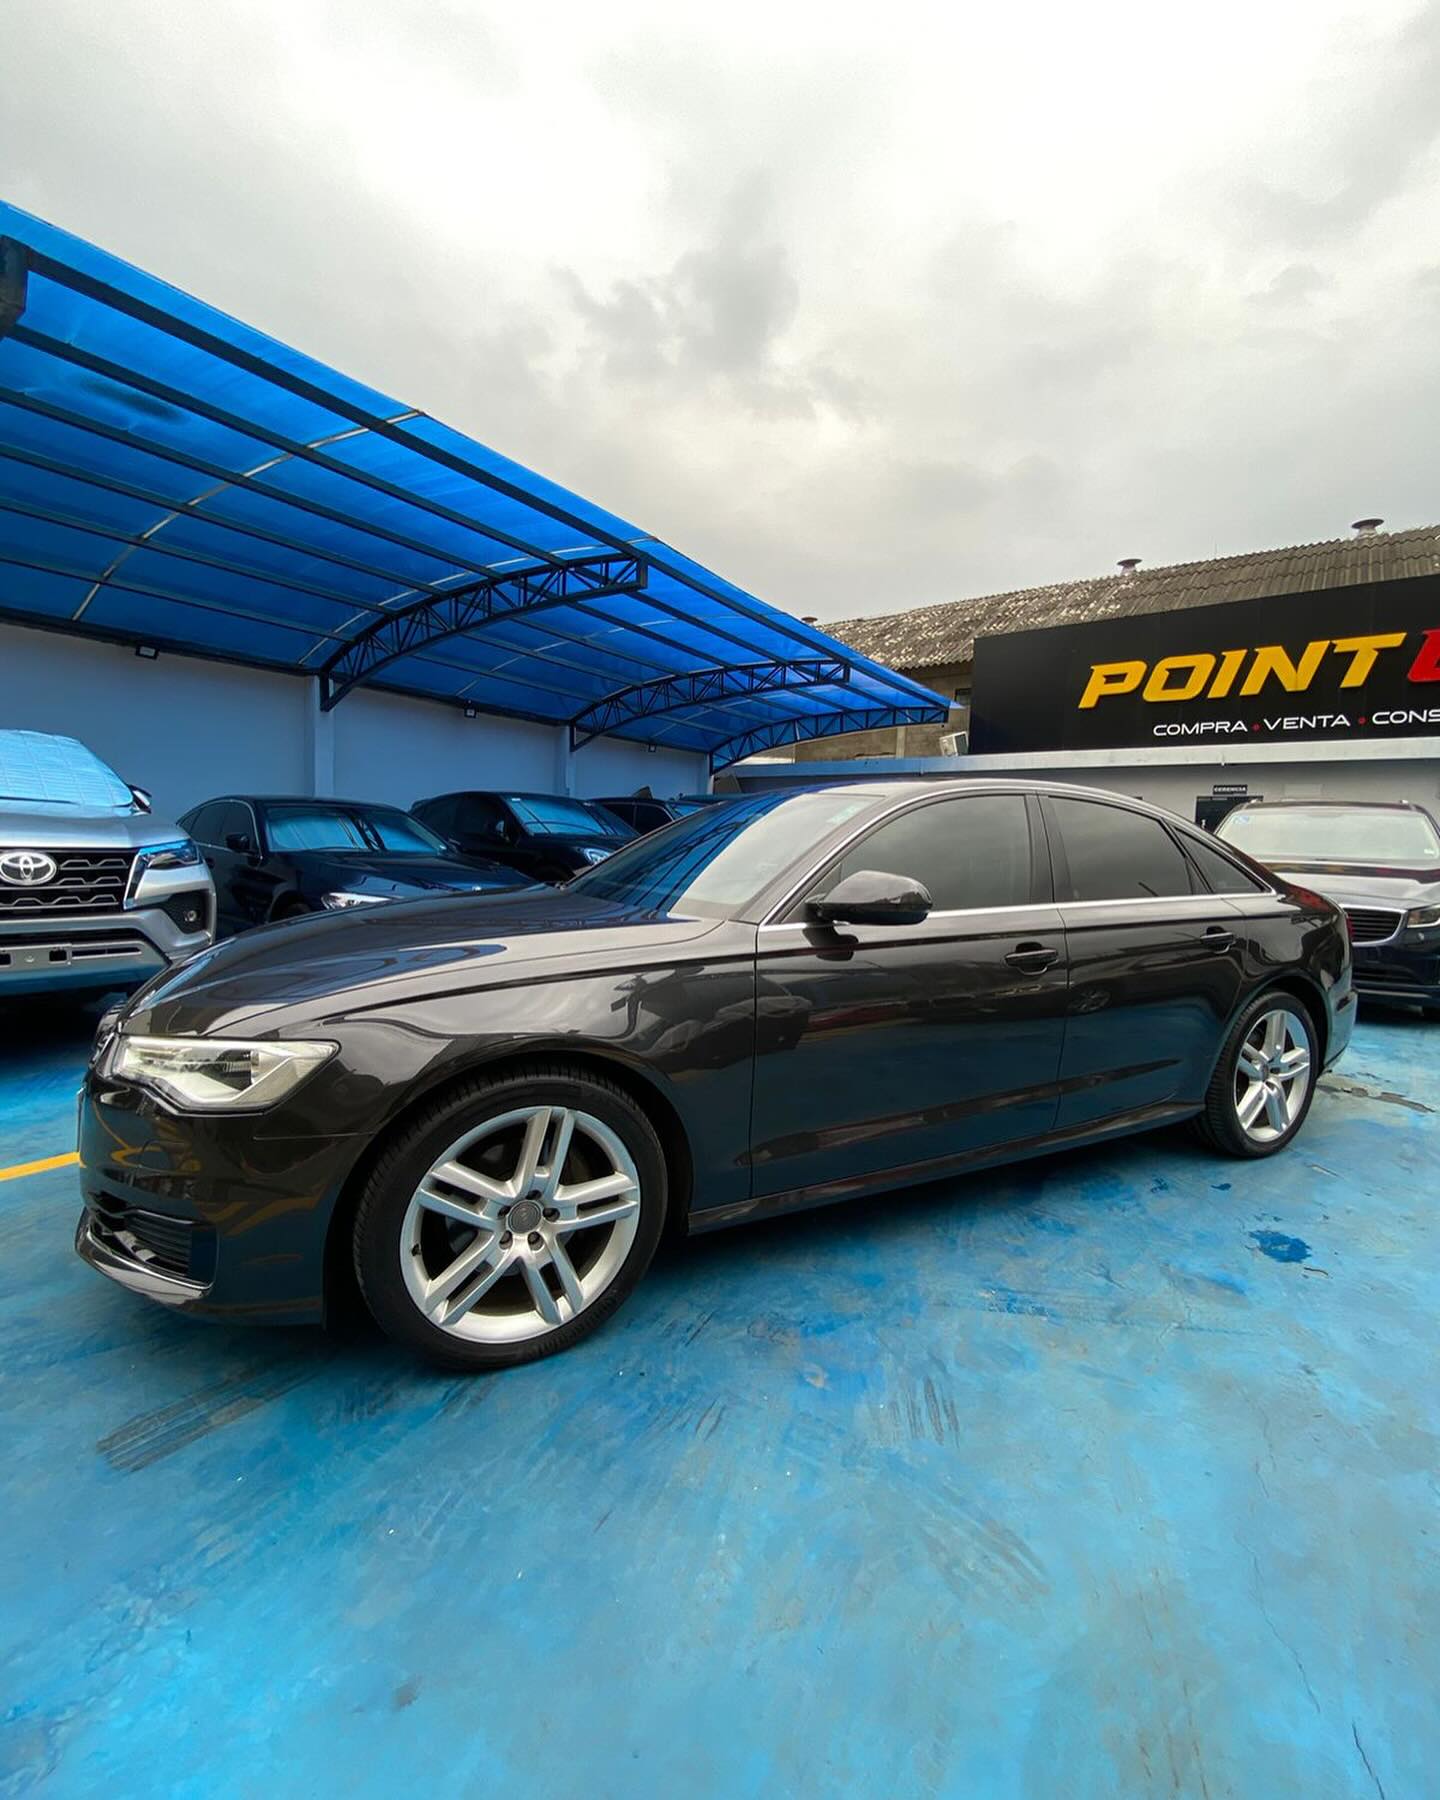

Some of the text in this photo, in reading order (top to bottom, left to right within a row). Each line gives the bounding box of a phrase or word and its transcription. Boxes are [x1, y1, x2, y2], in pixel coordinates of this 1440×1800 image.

[1078, 632, 1407, 708] POINT
[1153, 720, 1248, 736] COMPRA
[1263, 714, 1350, 731] VENTA
